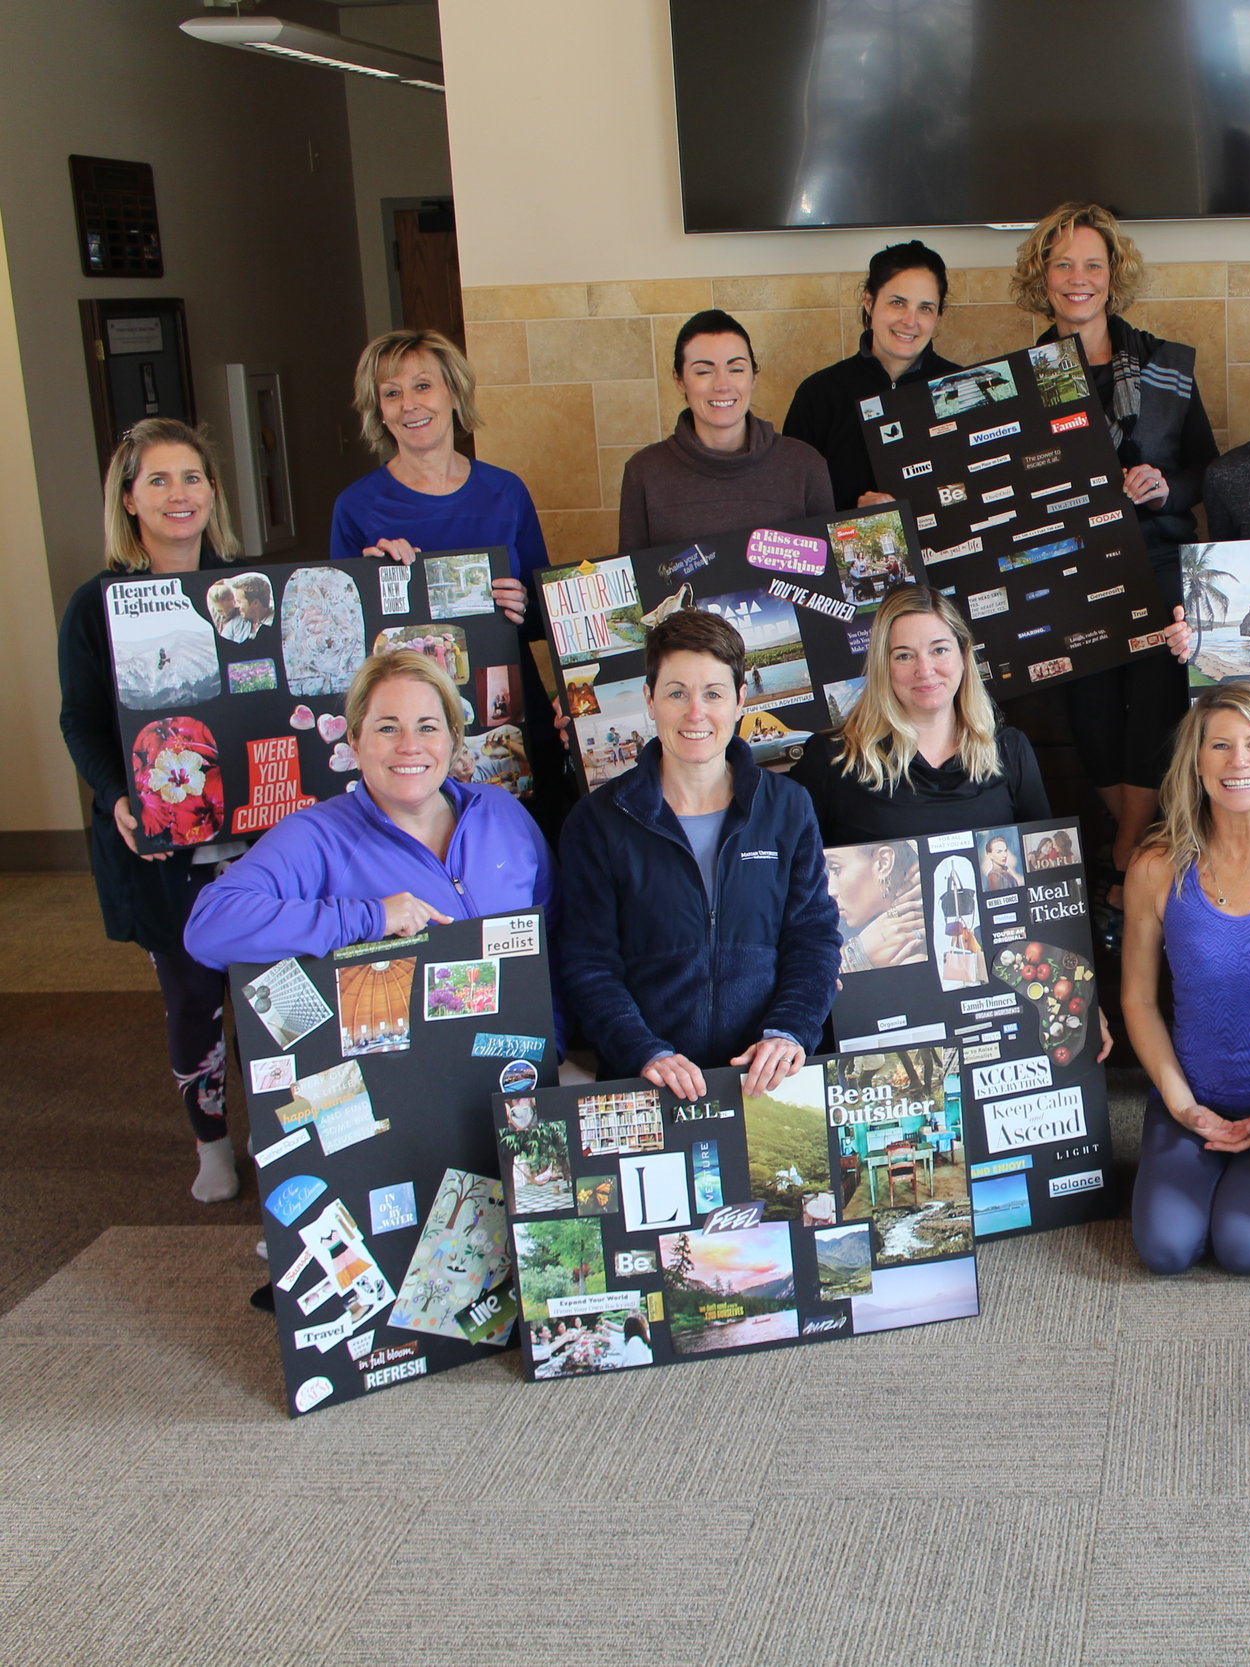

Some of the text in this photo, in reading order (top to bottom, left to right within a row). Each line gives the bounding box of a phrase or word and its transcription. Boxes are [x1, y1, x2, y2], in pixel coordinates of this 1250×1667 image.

[973, 425, 1018, 443] Wonders
[1052, 416, 1088, 433] Family
[1036, 451, 1054, 461] power
[903, 461, 932, 477] Time
[1092, 477, 1106, 485] KIDS
[940, 488, 964, 503] Be
[1090, 509, 1121, 525] TODAY
[750, 541, 801, 559] change
[752, 530, 819, 552] a kiss can
[748, 554, 826, 576] everything
[112, 580, 178, 599] Heart of
[544, 568, 636, 618] CALIFORNIA
[1089, 586, 1124, 601] Generosity
[113, 600, 190, 618] Lightness
[768, 579, 809, 606] YOU'VE
[806, 593, 856, 621] ARRIVED
[1133, 610, 1147, 618] True
[552, 612, 611, 656] DREAM
[253, 738, 297, 764] WERE
[258, 760, 290, 784] YOU
[253, 780, 297, 806] BORN
[1034, 855, 1079, 870] JOYFUL
[1027, 881, 1070, 904] Meal
[1030, 900, 1086, 924] Ticket
[509, 918, 534, 930] the
[487, 936, 534, 952] realist
[962, 998, 1014, 1012] Family Dinners
[879, 1019, 906, 1028] Organize
[488, 1037, 543, 1051] BACKYARD
[979, 1062, 1048, 1087] ACCESS
[828, 1084, 893, 1107] Be an
[976, 1076, 1050, 1097] IS EVERYTHING
[282, 1105, 319, 1125] happy
[674, 1103, 719, 1123] ALL
[829, 1099, 935, 1127] Outsider
[992, 1092, 1079, 1122] Keep Calm
[997, 1109, 1081, 1146] Ascend
[259, 1132, 307, 1164] Gather Round
[971, 1160, 1026, 1178] AND ENJOY!
[1052, 1175, 1101, 1191] balance
[635, 1166, 679, 1226] L
[703, 1205, 761, 1235] FEEL
[286, 1250, 313, 1283] Sunset
[618, 1253, 650, 1273] Be
[606, 1294, 629, 1303] World
[303, 1324, 345, 1344] Travel
[358, 1346, 415, 1371] in full bloom.
